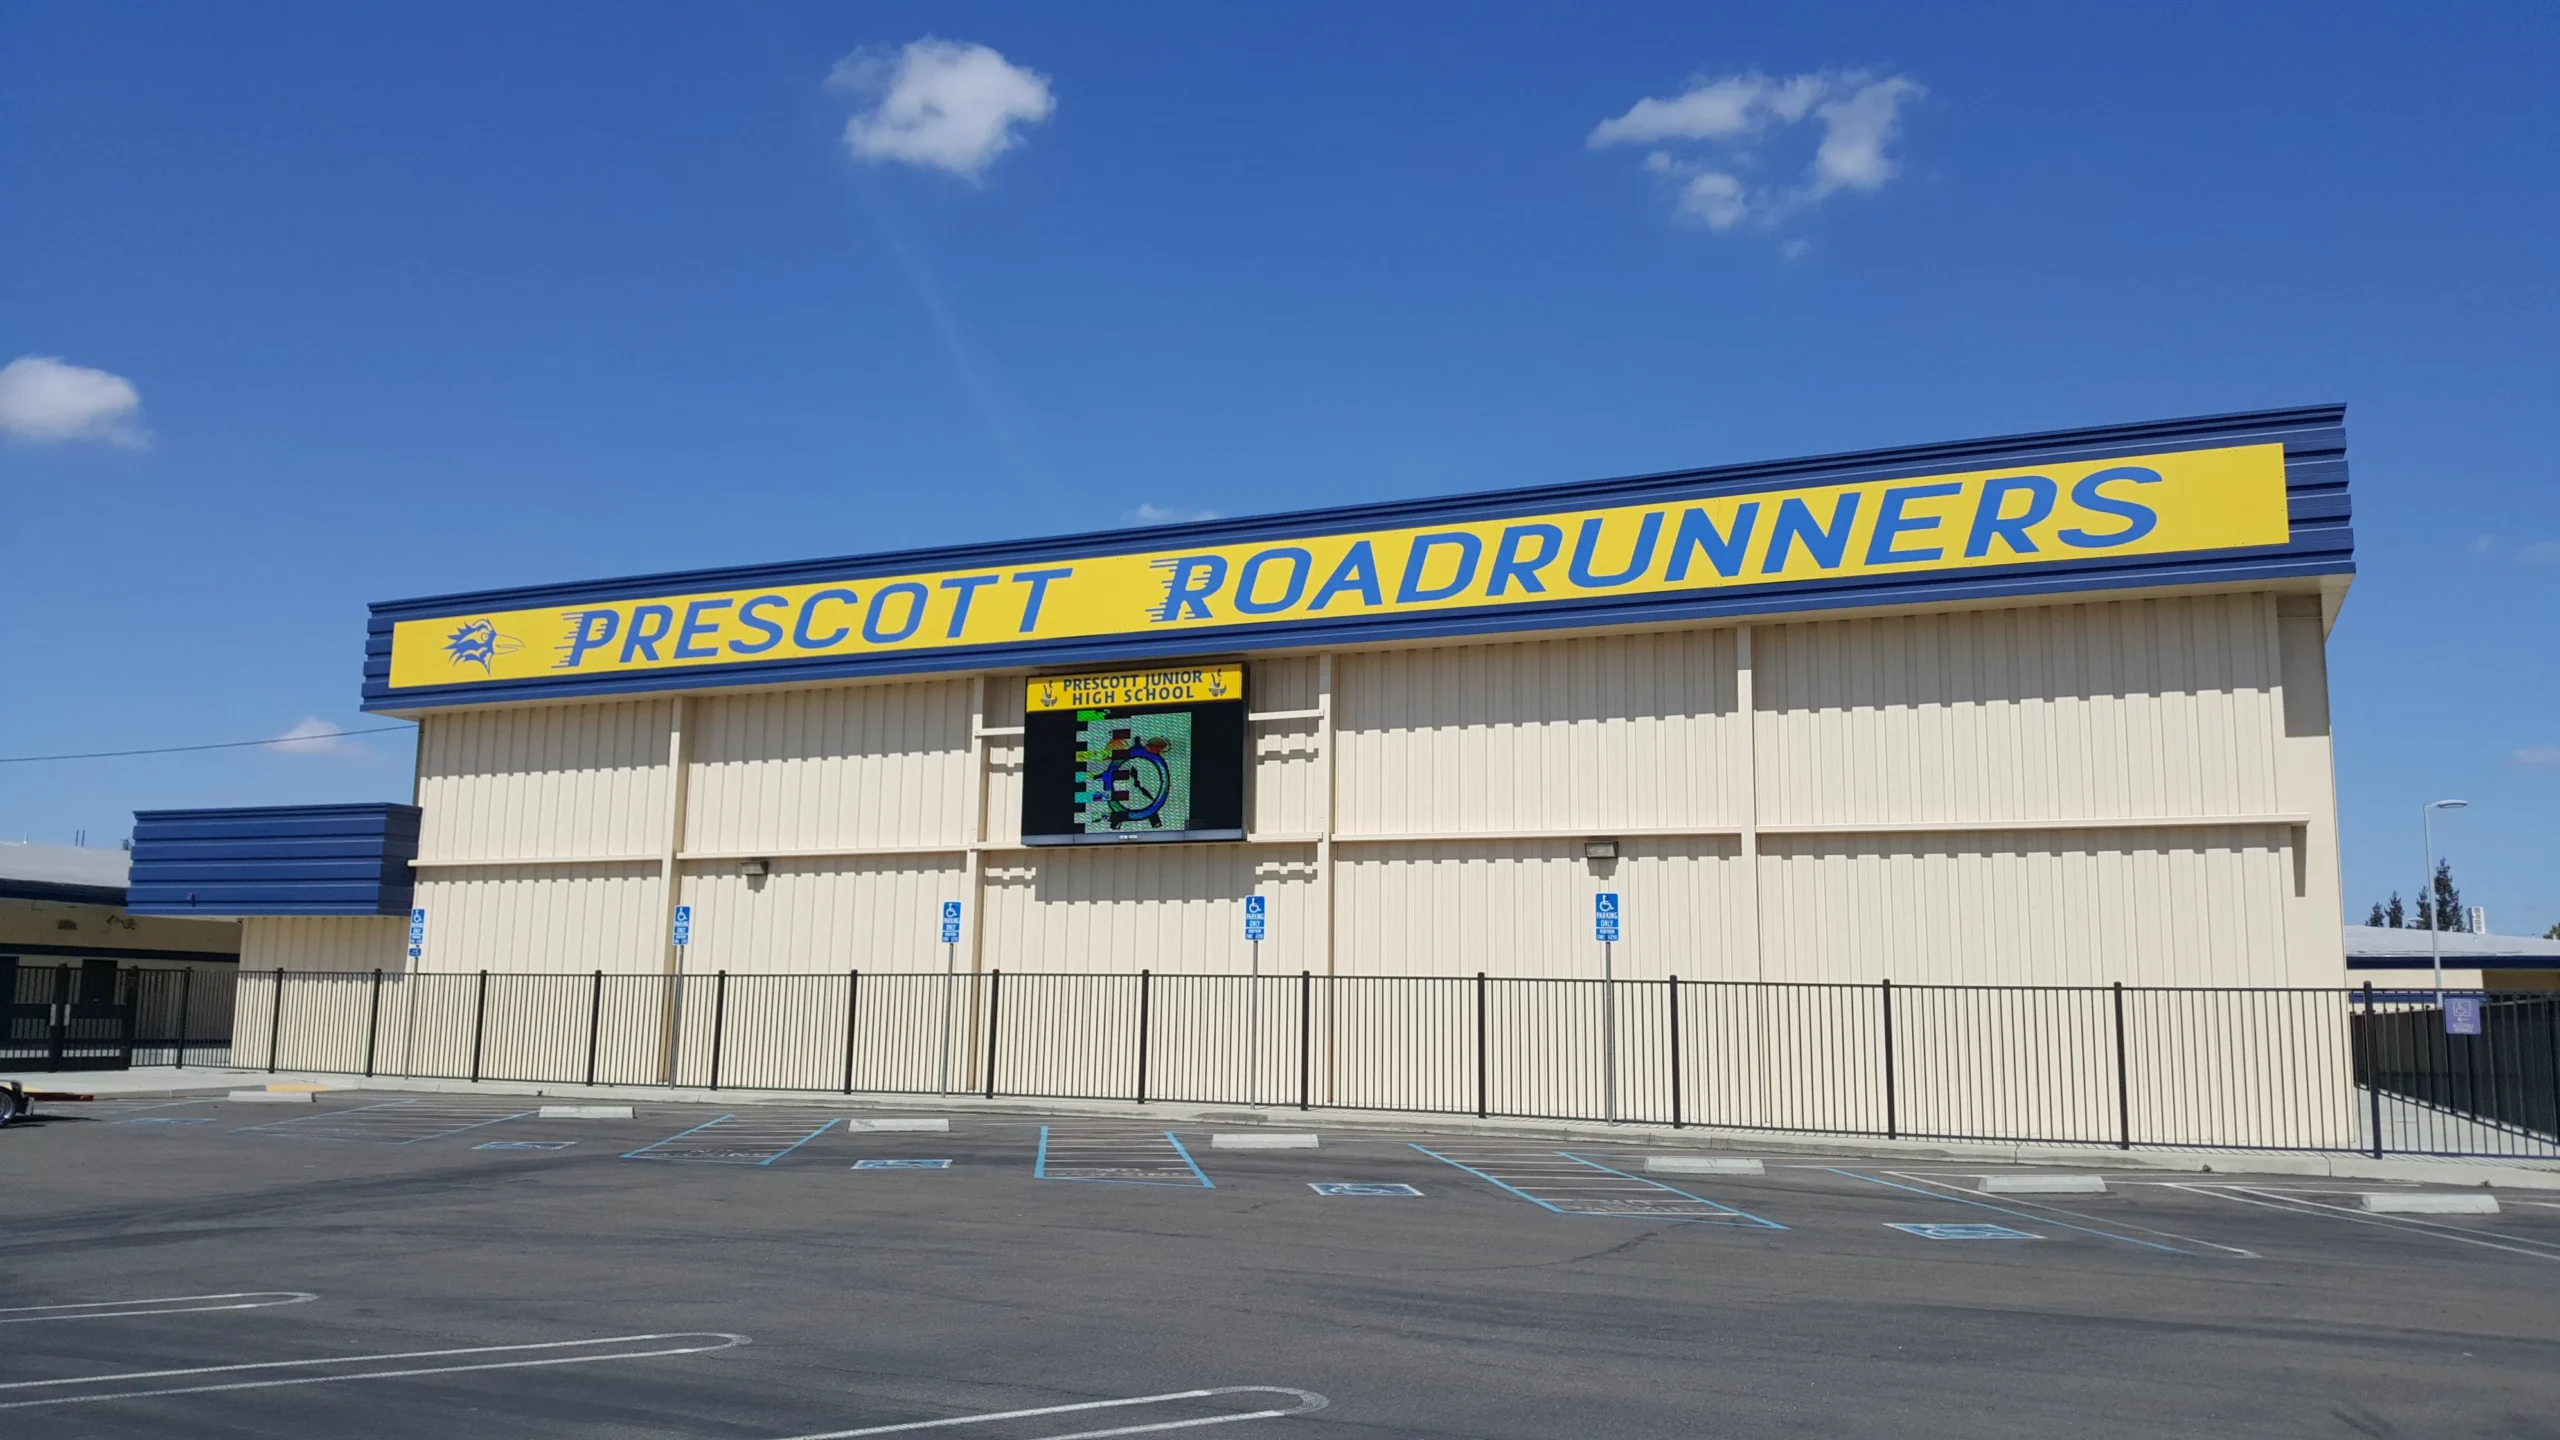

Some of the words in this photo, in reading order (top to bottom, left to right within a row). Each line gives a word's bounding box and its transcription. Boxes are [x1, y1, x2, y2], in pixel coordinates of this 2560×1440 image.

[551, 567, 1073, 669] PRESCOTT
[1148, 466, 2163, 623] ROADRUNNERS
[1063, 674, 1139, 692] PRESCOTT
[1144, 670, 1203, 689] JUNIOR
[1073, 691, 1115, 705] HIGH
[1124, 686, 1194, 703] SCHOOL
[1596, 911, 1618, 919] PARKING
[1600, 919, 1614, 927] ONLY
